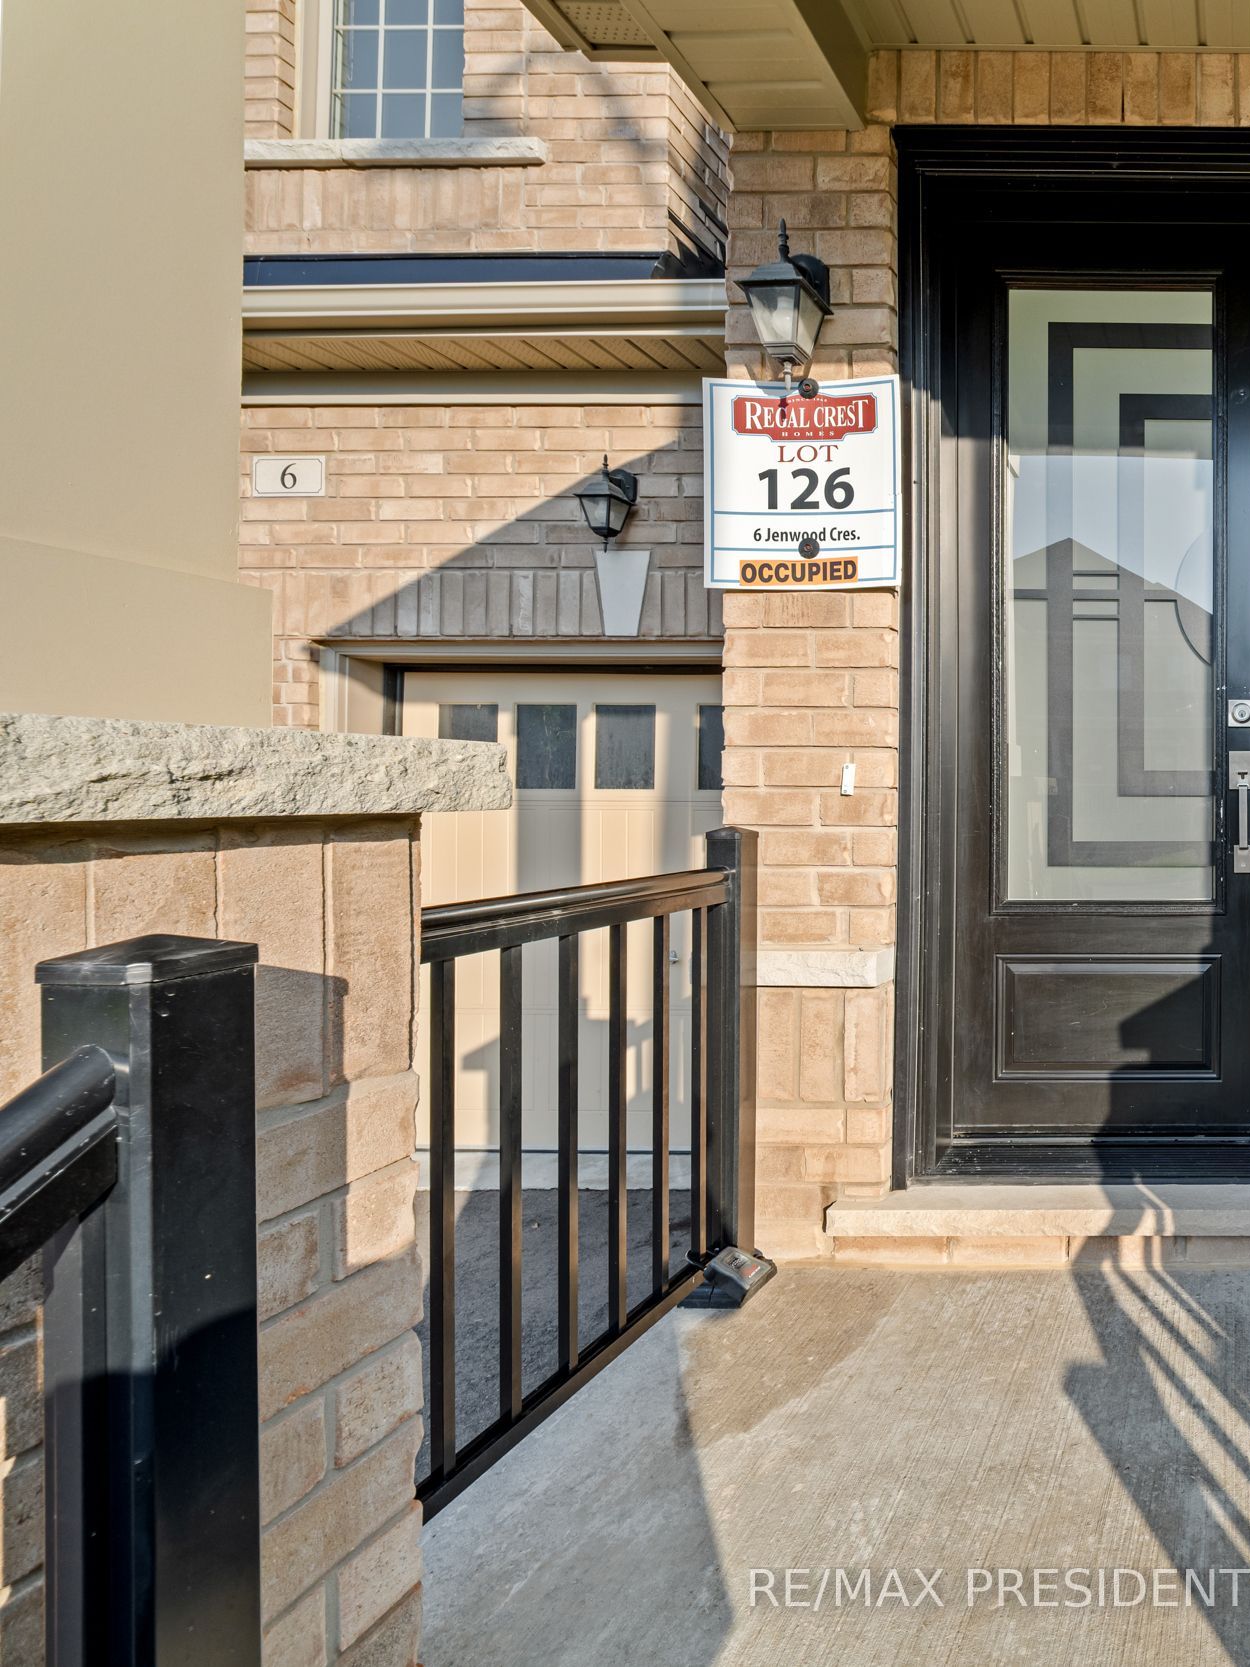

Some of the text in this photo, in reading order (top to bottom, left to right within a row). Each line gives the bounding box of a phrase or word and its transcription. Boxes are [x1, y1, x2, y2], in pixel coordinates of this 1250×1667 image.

[745, 399, 868, 429] REGAL CREST
[778, 445, 839, 462] LOT
[280, 462, 298, 489] 6
[758, 467, 855, 510] 126
[753, 527, 861, 542] 6 Jenwood Cres.
[741, 560, 857, 583] OCCUPIED
